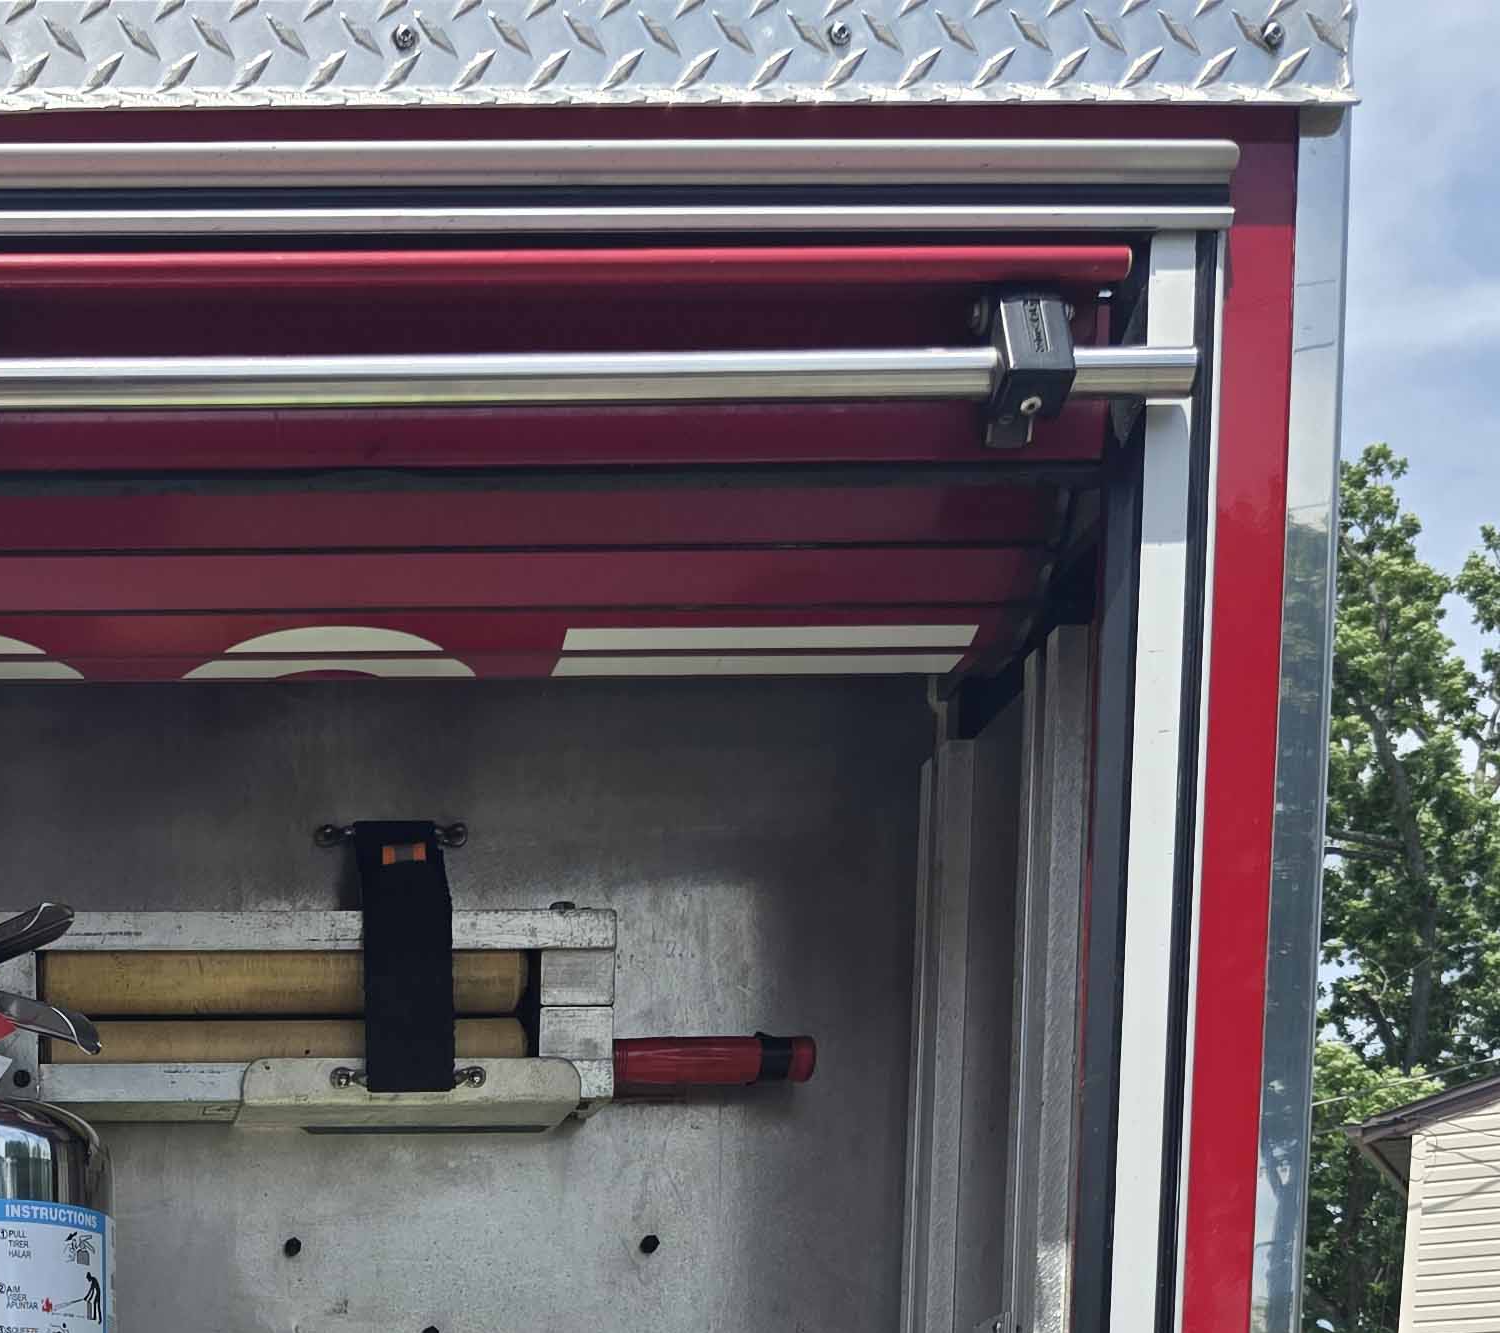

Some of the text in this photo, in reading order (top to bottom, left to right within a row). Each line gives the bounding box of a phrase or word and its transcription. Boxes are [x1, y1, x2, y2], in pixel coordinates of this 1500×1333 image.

[5, 1204, 98, 1229] INSTRUCTIONS
[8, 1230, 26, 1238] PULL
[8, 1240, 28, 1248] TIRER
[8, 1250, 31, 1259] HALAR
[6, 1285, 20, 1293] AIM
[6, 1301, 38, 1310] APUNTAR
